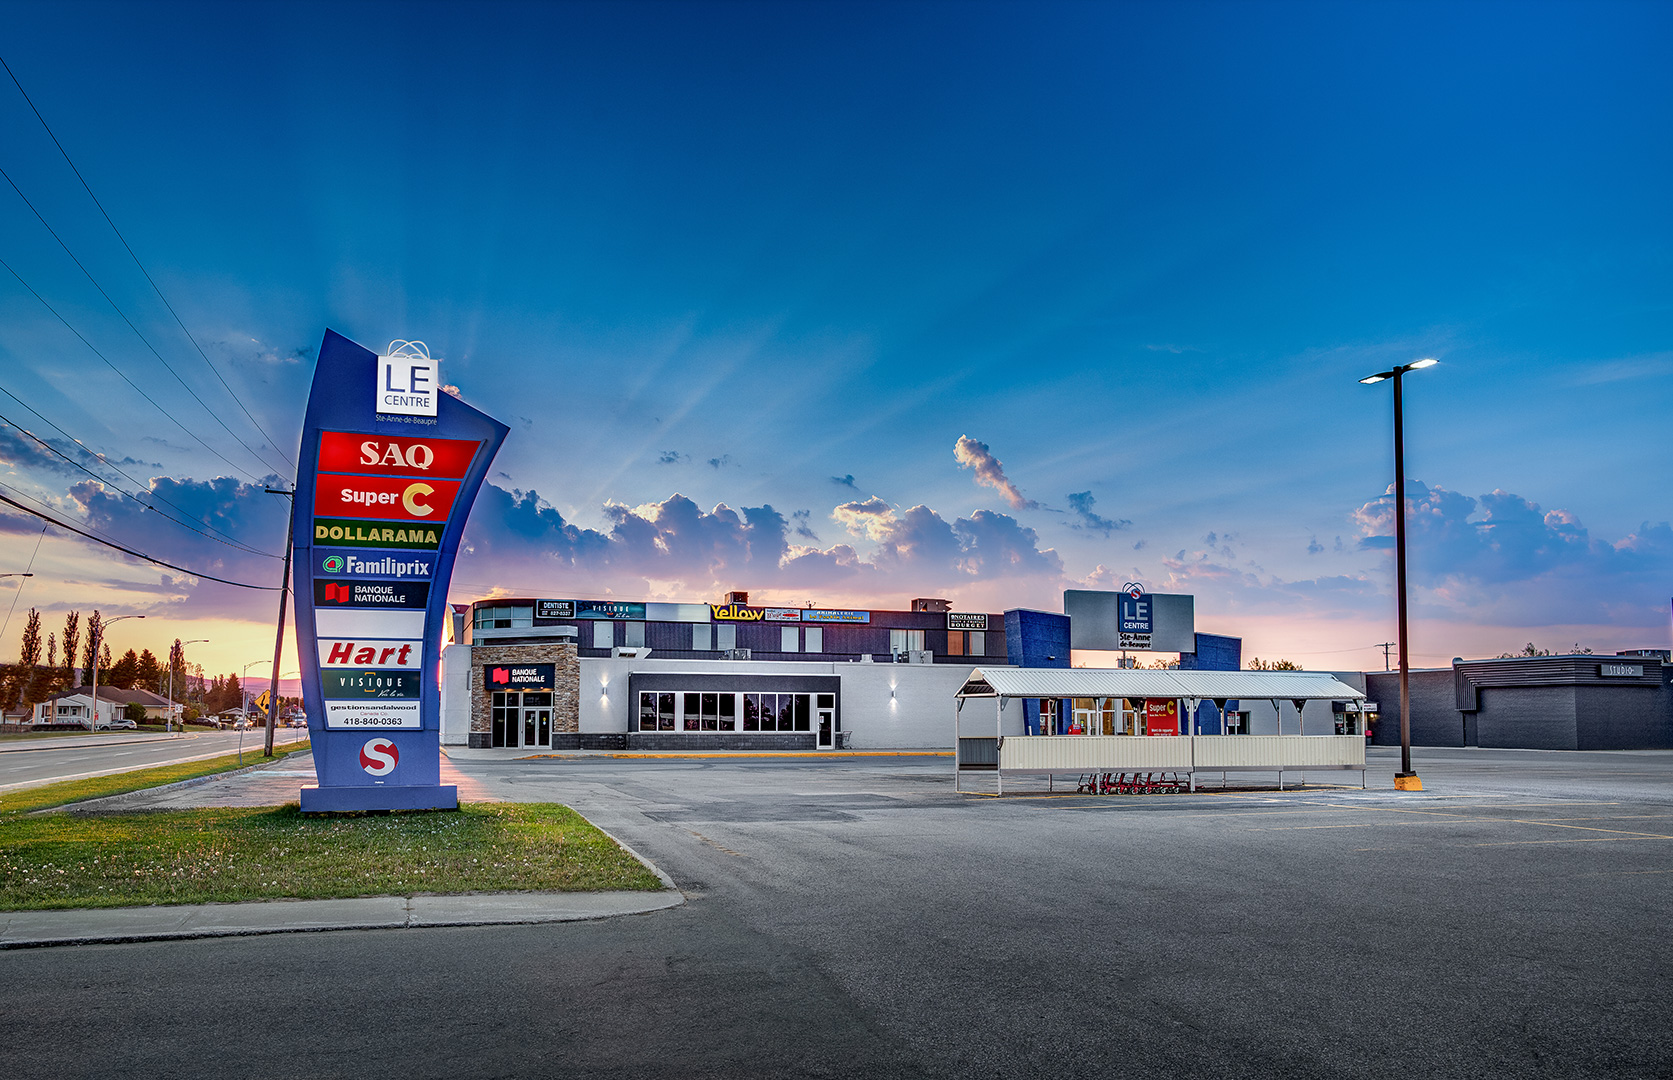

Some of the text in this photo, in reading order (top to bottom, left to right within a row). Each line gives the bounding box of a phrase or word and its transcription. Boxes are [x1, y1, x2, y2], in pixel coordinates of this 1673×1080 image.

[386, 364, 430, 394] LE
[384, 395, 430, 407] CENTRE
[375, 414, 438, 426] Ste-Anne-de-Beaupré
[360, 441, 434, 470] SAQ
[341, 482, 435, 516] Super C
[315, 525, 438, 543] DOLLARAMA
[346, 556, 429, 577] Familiprix
[354, 586, 394, 594] BANQUE
[354, 594, 406, 603] NATIONALE
[711, 604, 764, 620] Yellow
[1124, 602, 1148, 620] LE
[1120, 633, 1151, 641] Ste-Anne
[327, 642, 412, 665] Hart
[340, 678, 402, 687] VISIQUE
[1149, 701, 1175, 715] Super C
